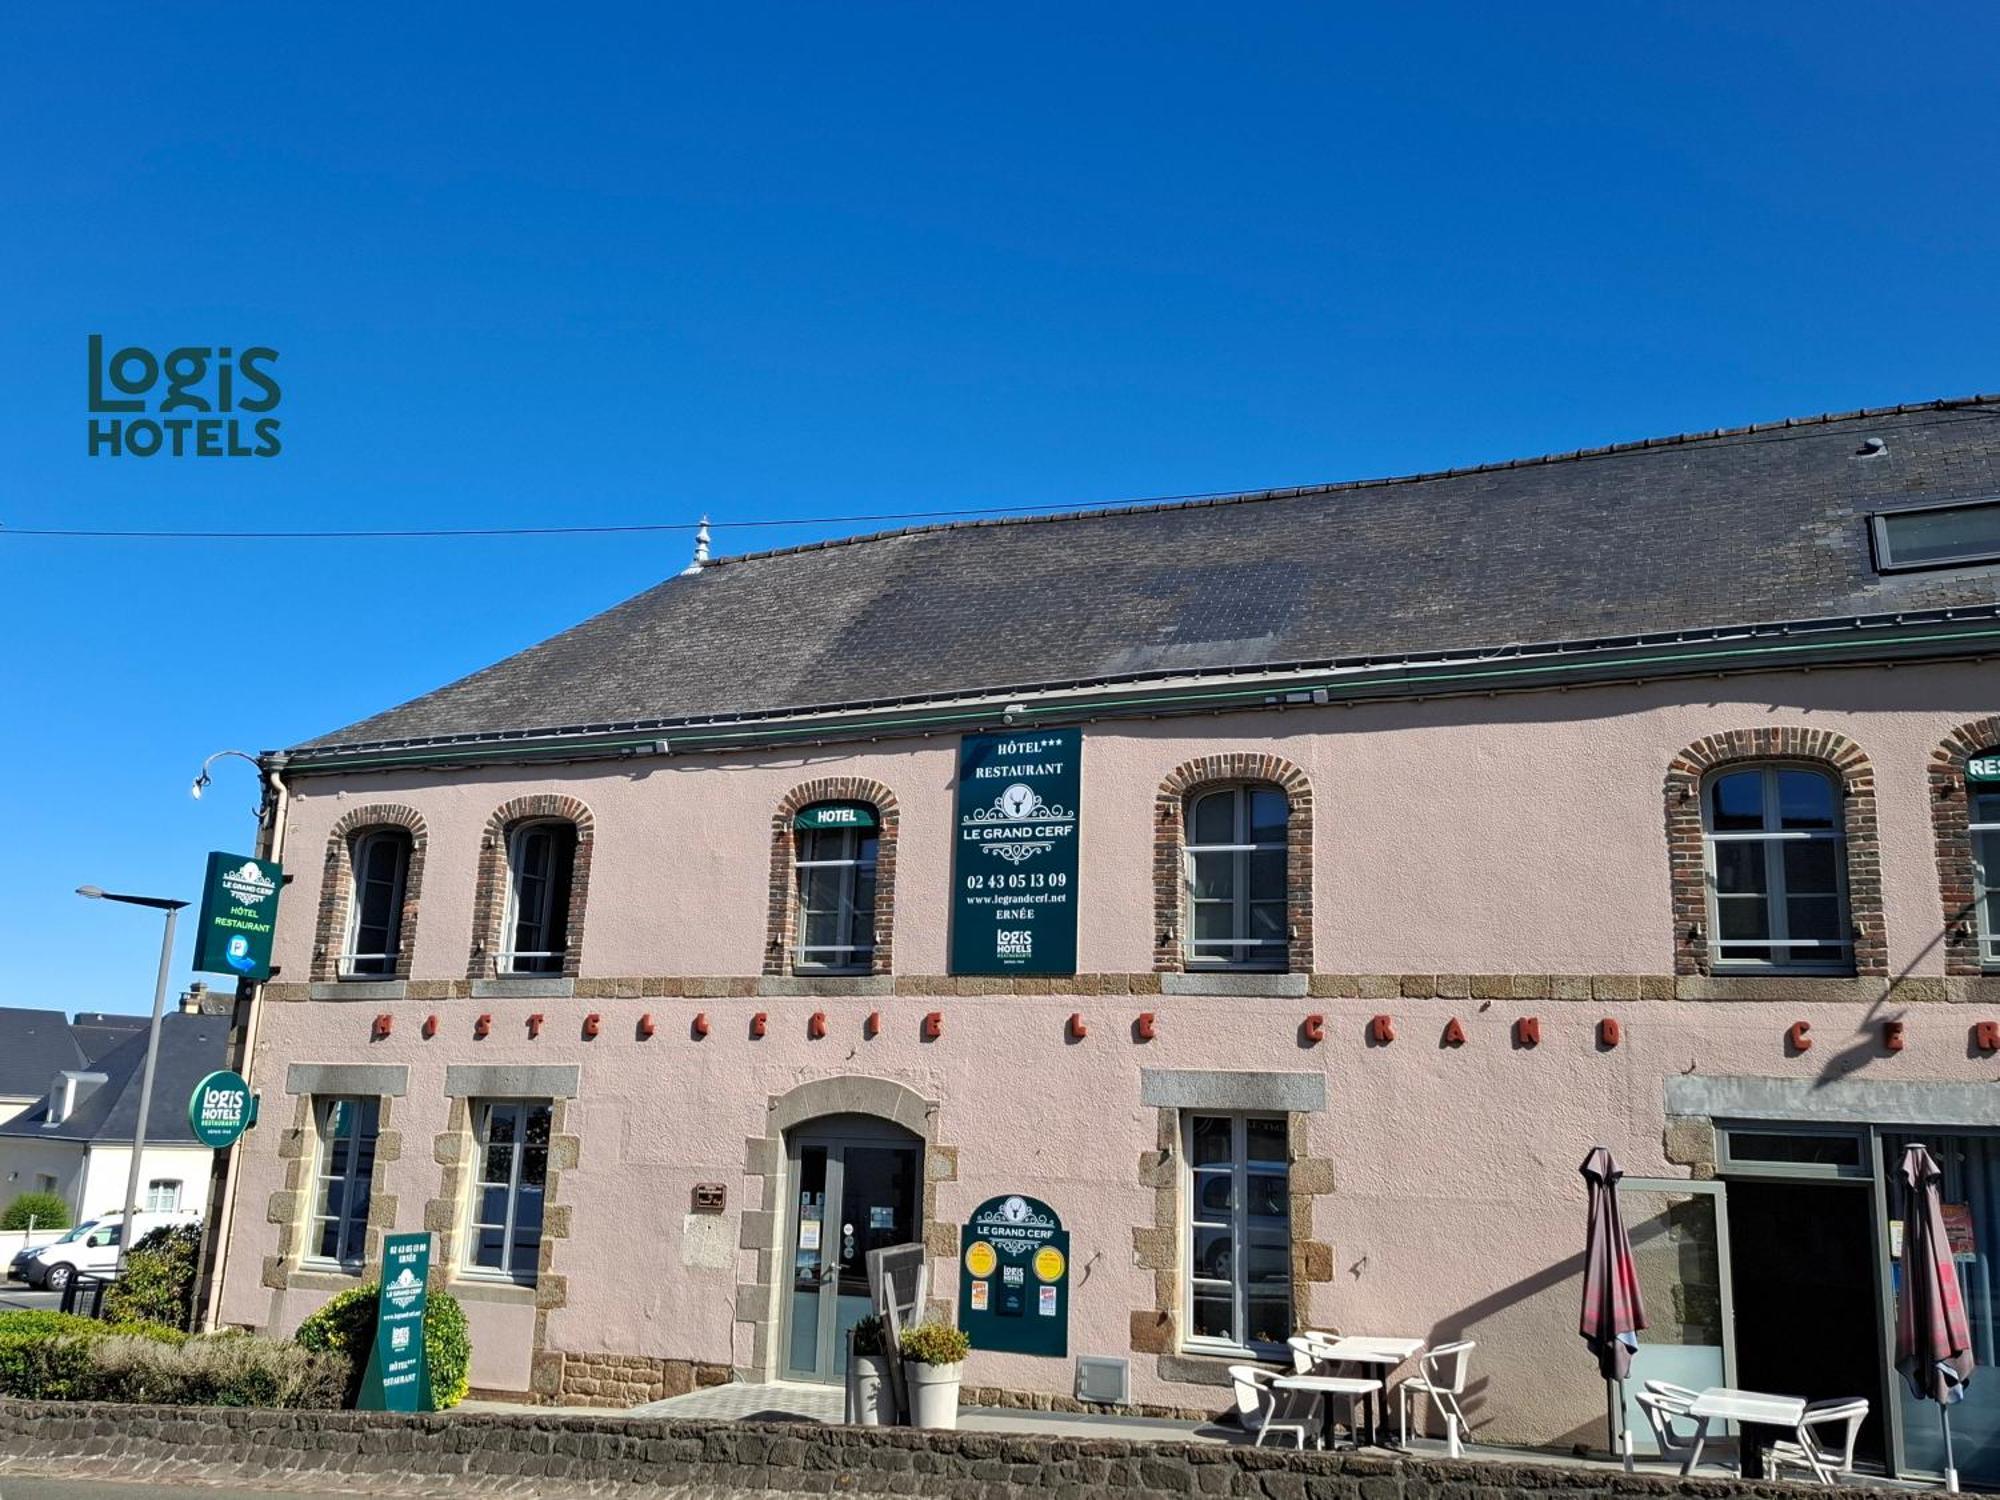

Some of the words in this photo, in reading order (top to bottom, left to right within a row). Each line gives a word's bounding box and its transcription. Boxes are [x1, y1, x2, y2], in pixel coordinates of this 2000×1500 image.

[976, 763, 1064, 778] RESTAURANT
[818, 809, 856, 823] HOTEL
[964, 829, 980, 840] LE
[984, 827, 1032, 838] GRAND
[1036, 825, 1074, 836] CERF
[968, 875, 984, 889] 02
[988, 874, 1004, 888] 43
[1008, 874, 1026, 888] 05
[1030, 874, 1044, 888] 13
[1048, 873, 1066, 887] 09
[966, 893, 1066, 905] www.legrandcerf.net
[230, 906, 259, 918] HÔTEL
[996, 907, 1035, 920] ERNÉE
[214, 917, 270, 933] RESTAURANT
[997, 945, 1032, 953] HOTELS
[202, 1108, 242, 1120] HOTELS
[977, 1226, 990, 1235] LE
[991, 1227, 1025, 1237] GRAND
[1027, 1229, 1054, 1238] CERF
